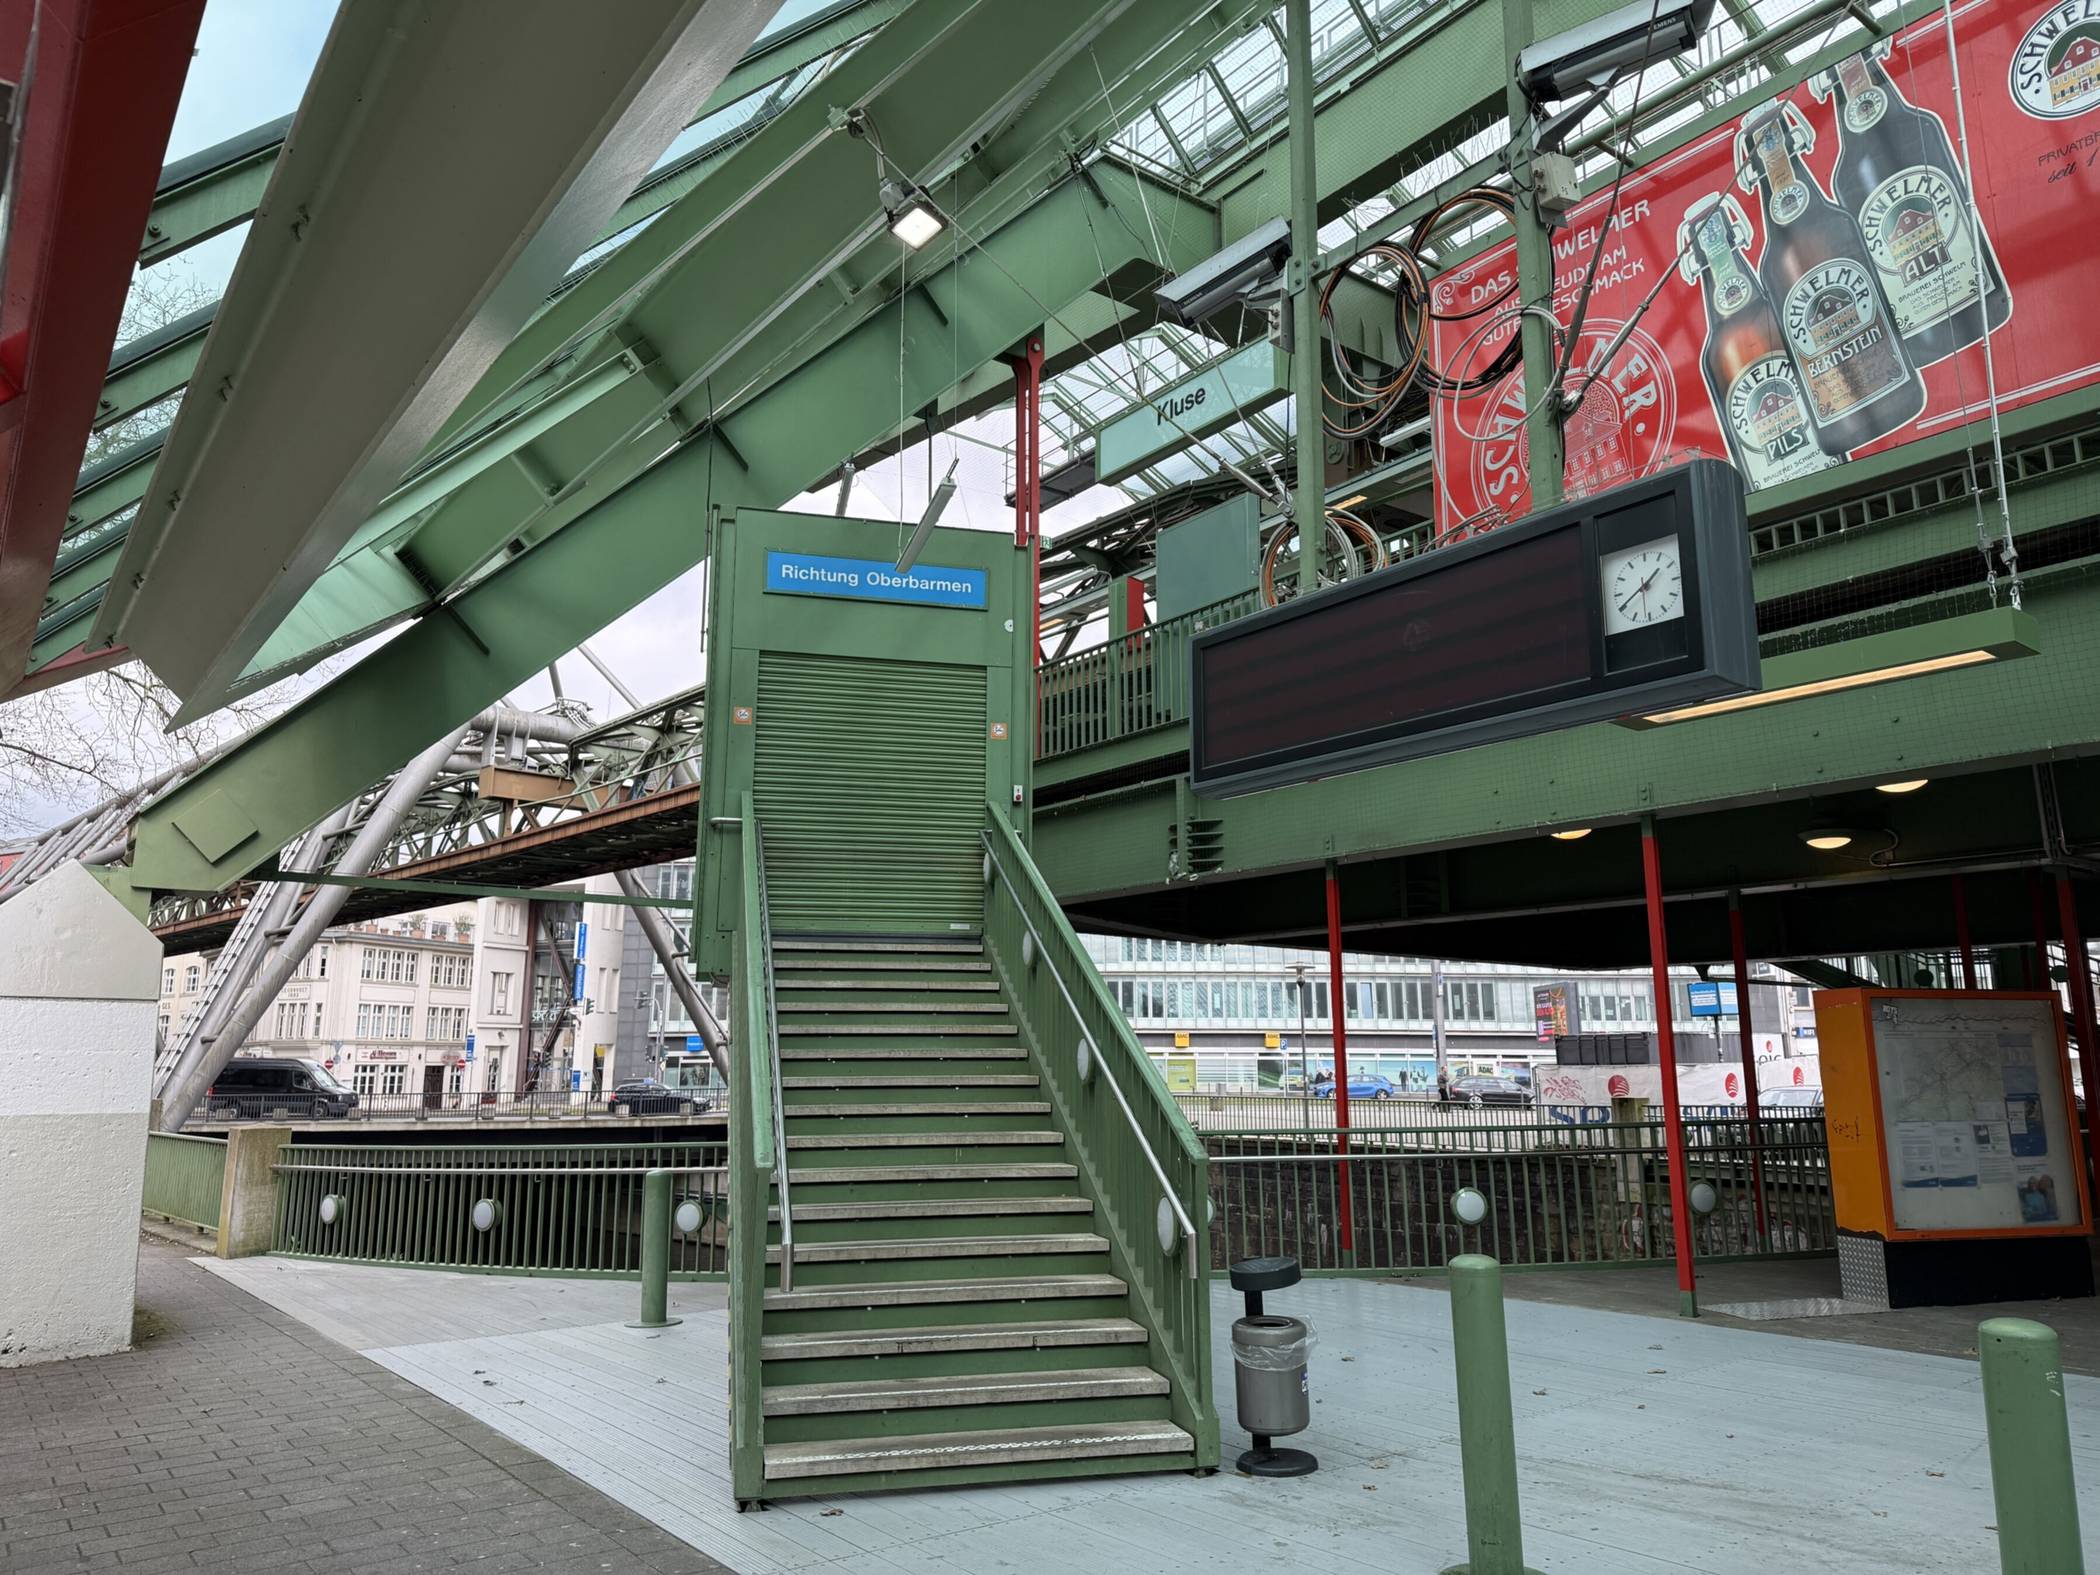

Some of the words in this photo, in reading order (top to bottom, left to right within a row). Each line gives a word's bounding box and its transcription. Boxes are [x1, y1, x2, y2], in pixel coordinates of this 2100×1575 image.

[1866, 175, 1952, 252] SCHWELMER
[1601, 245, 1627, 271] AM
[1906, 241, 1945, 283] ALT
[1471, 271, 1511, 304] DAS
[1790, 267, 1869, 340] SCHWELMER
[1807, 325, 1883, 377] BERNSTEIN
[1156, 387, 1206, 426] Kluse
[1767, 428, 1804, 461] PILS
[781, 564, 859, 587] Richtung
[866, 571, 972, 593] Oberbarmen
